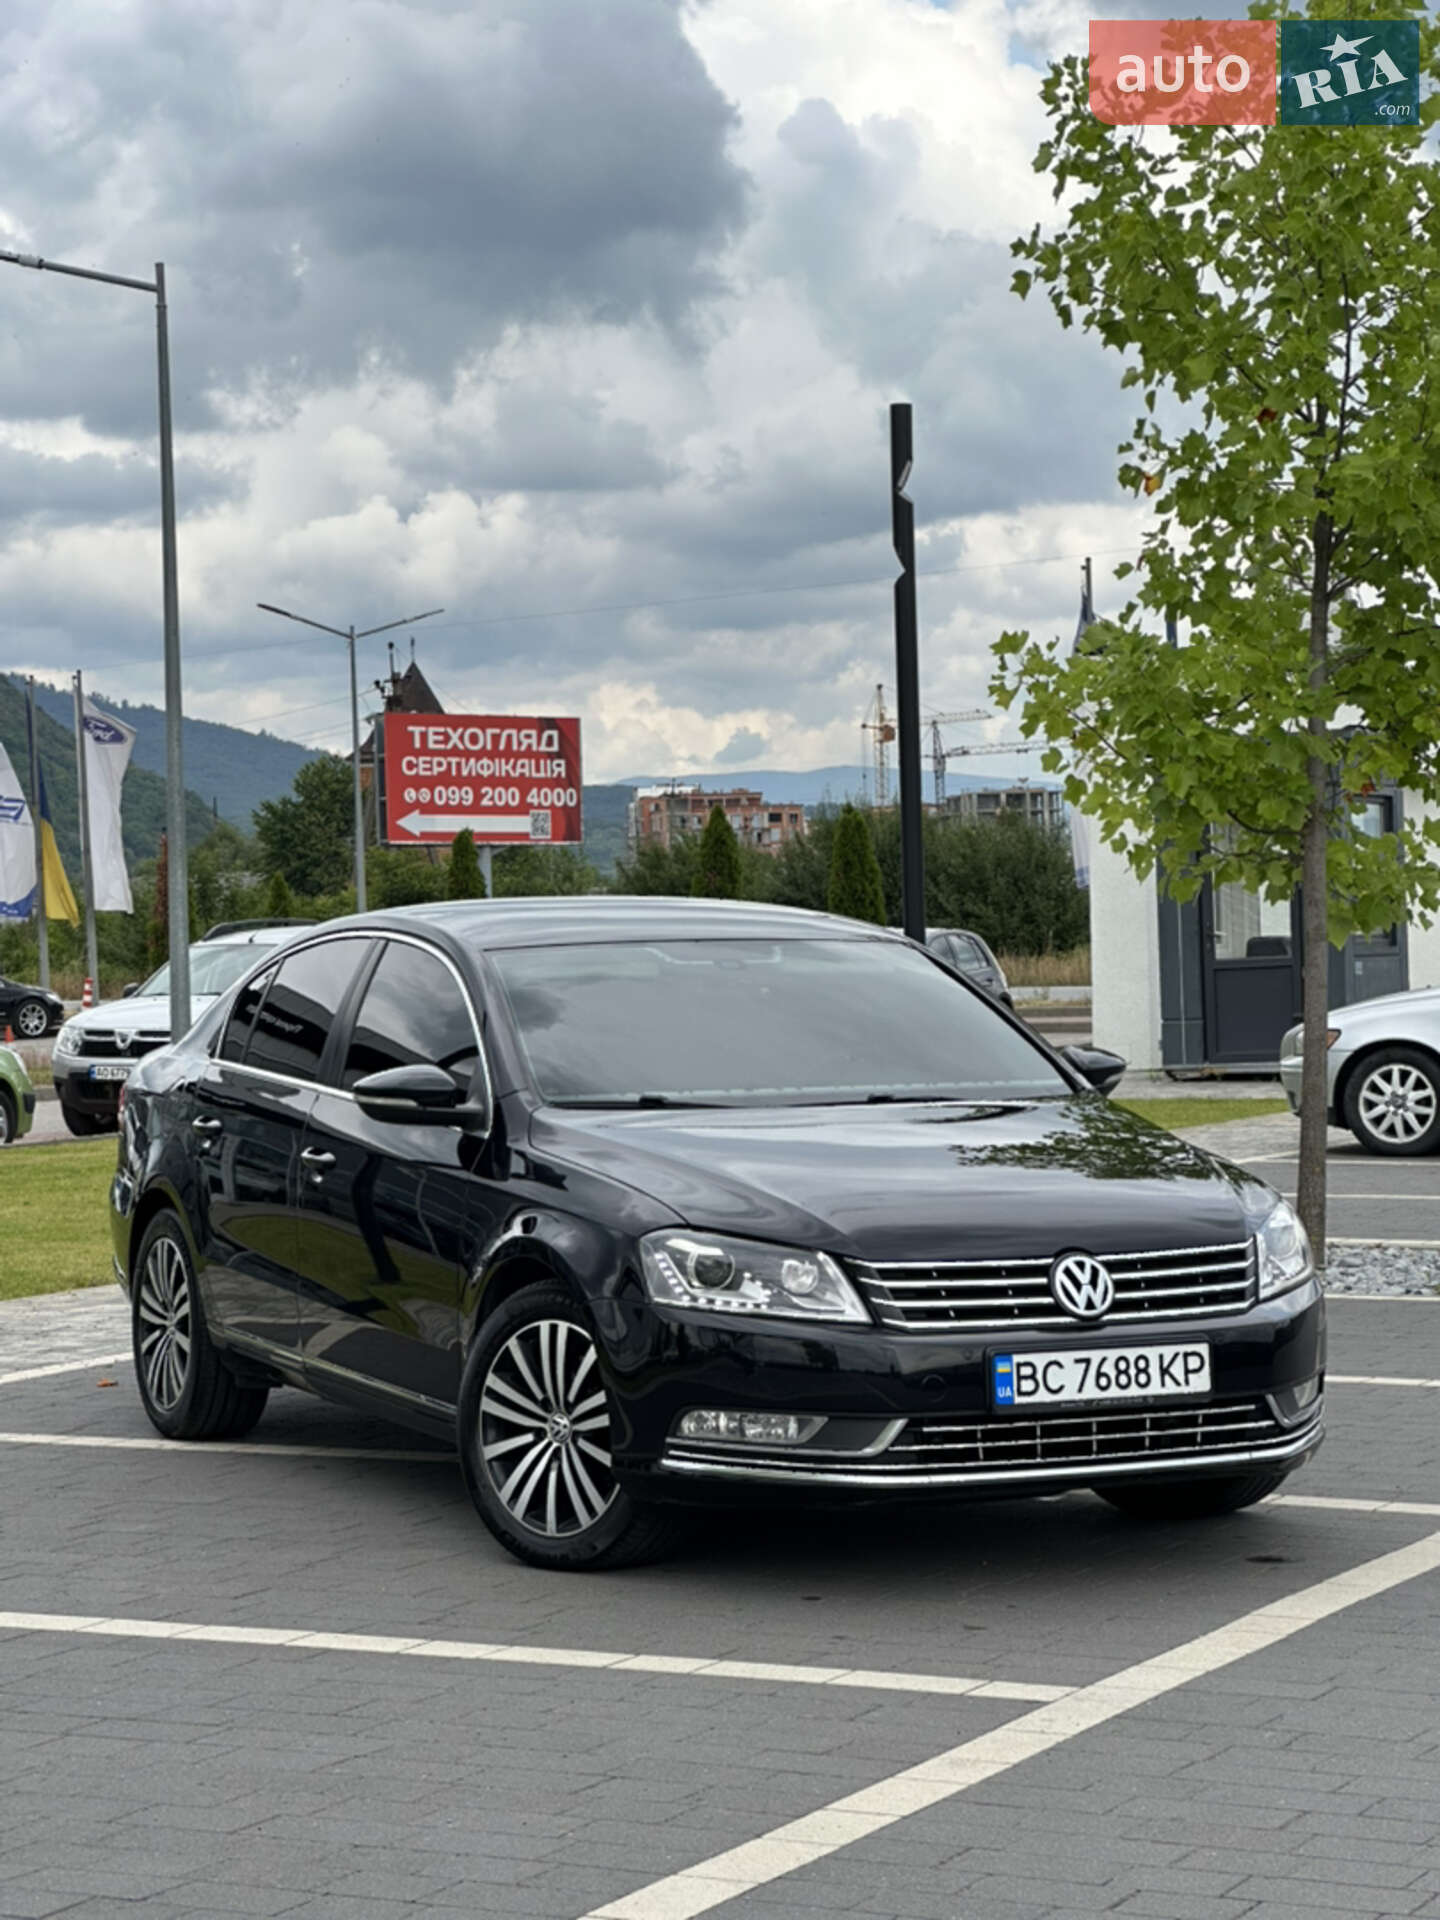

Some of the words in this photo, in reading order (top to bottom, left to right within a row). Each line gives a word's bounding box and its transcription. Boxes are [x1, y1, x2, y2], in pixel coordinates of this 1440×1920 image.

[406, 725, 560, 752] ТЕХОГЛЯД
[401, 755, 566, 779] СЕРТИФІКАЦІЯ
[433, 785, 475, 806] 099
[480, 786, 520, 807] 200
[526, 787, 577, 808] 4000
[1015, 1360, 1066, 1398] BC
[1073, 1354, 1152, 1394] 7688
[1158, 1350, 1206, 1388] KP
[997, 1386, 1013, 1398] UA
